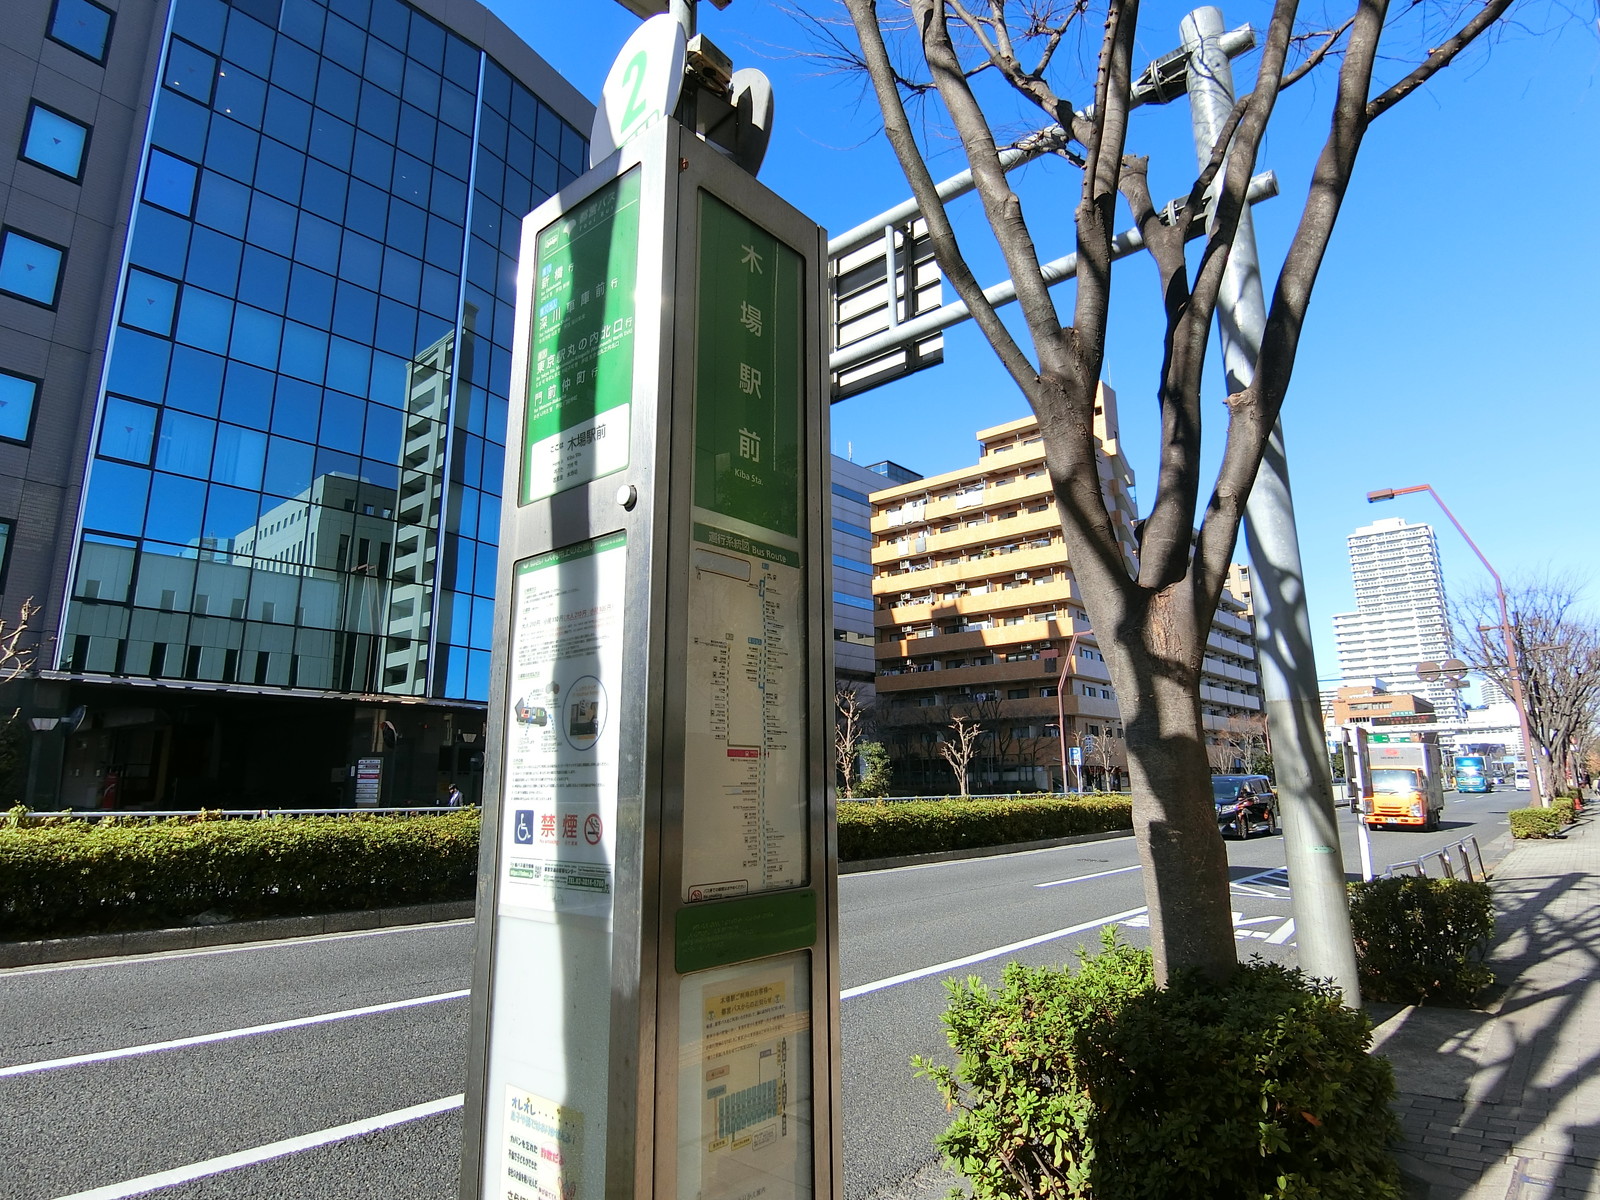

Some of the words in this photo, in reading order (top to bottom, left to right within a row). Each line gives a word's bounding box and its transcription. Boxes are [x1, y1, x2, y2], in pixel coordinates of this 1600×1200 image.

[620, 50, 648, 135] 2
[738, 243, 763, 464] 木場駅前
[567, 424, 607, 452] 木場駅前
[734, 468, 750, 481] Kiba
[751, 473, 764, 486] Sta.
[752, 545, 765, 557] Bus
[766, 549, 787, 563] Route
[540, 813, 578, 839] 禁煙
